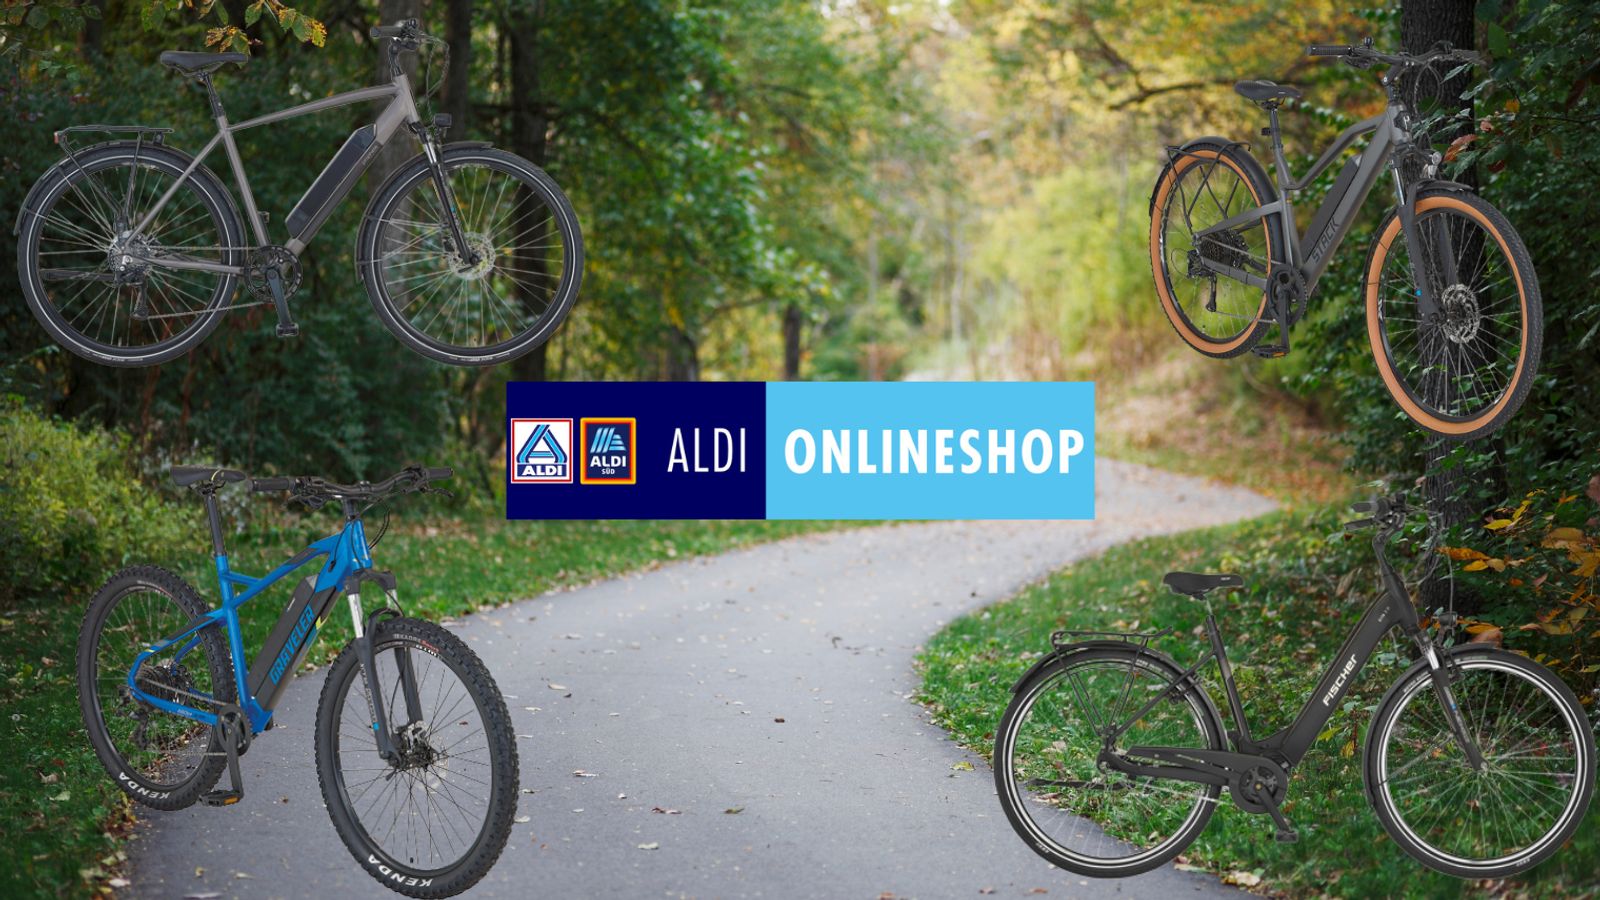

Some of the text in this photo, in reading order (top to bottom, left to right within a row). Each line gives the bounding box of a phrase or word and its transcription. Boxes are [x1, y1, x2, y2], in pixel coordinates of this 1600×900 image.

[268, 603, 316, 686] GRAVELER
[119, 771, 170, 799] KENDA
[368, 854, 433, 887] KENDA
